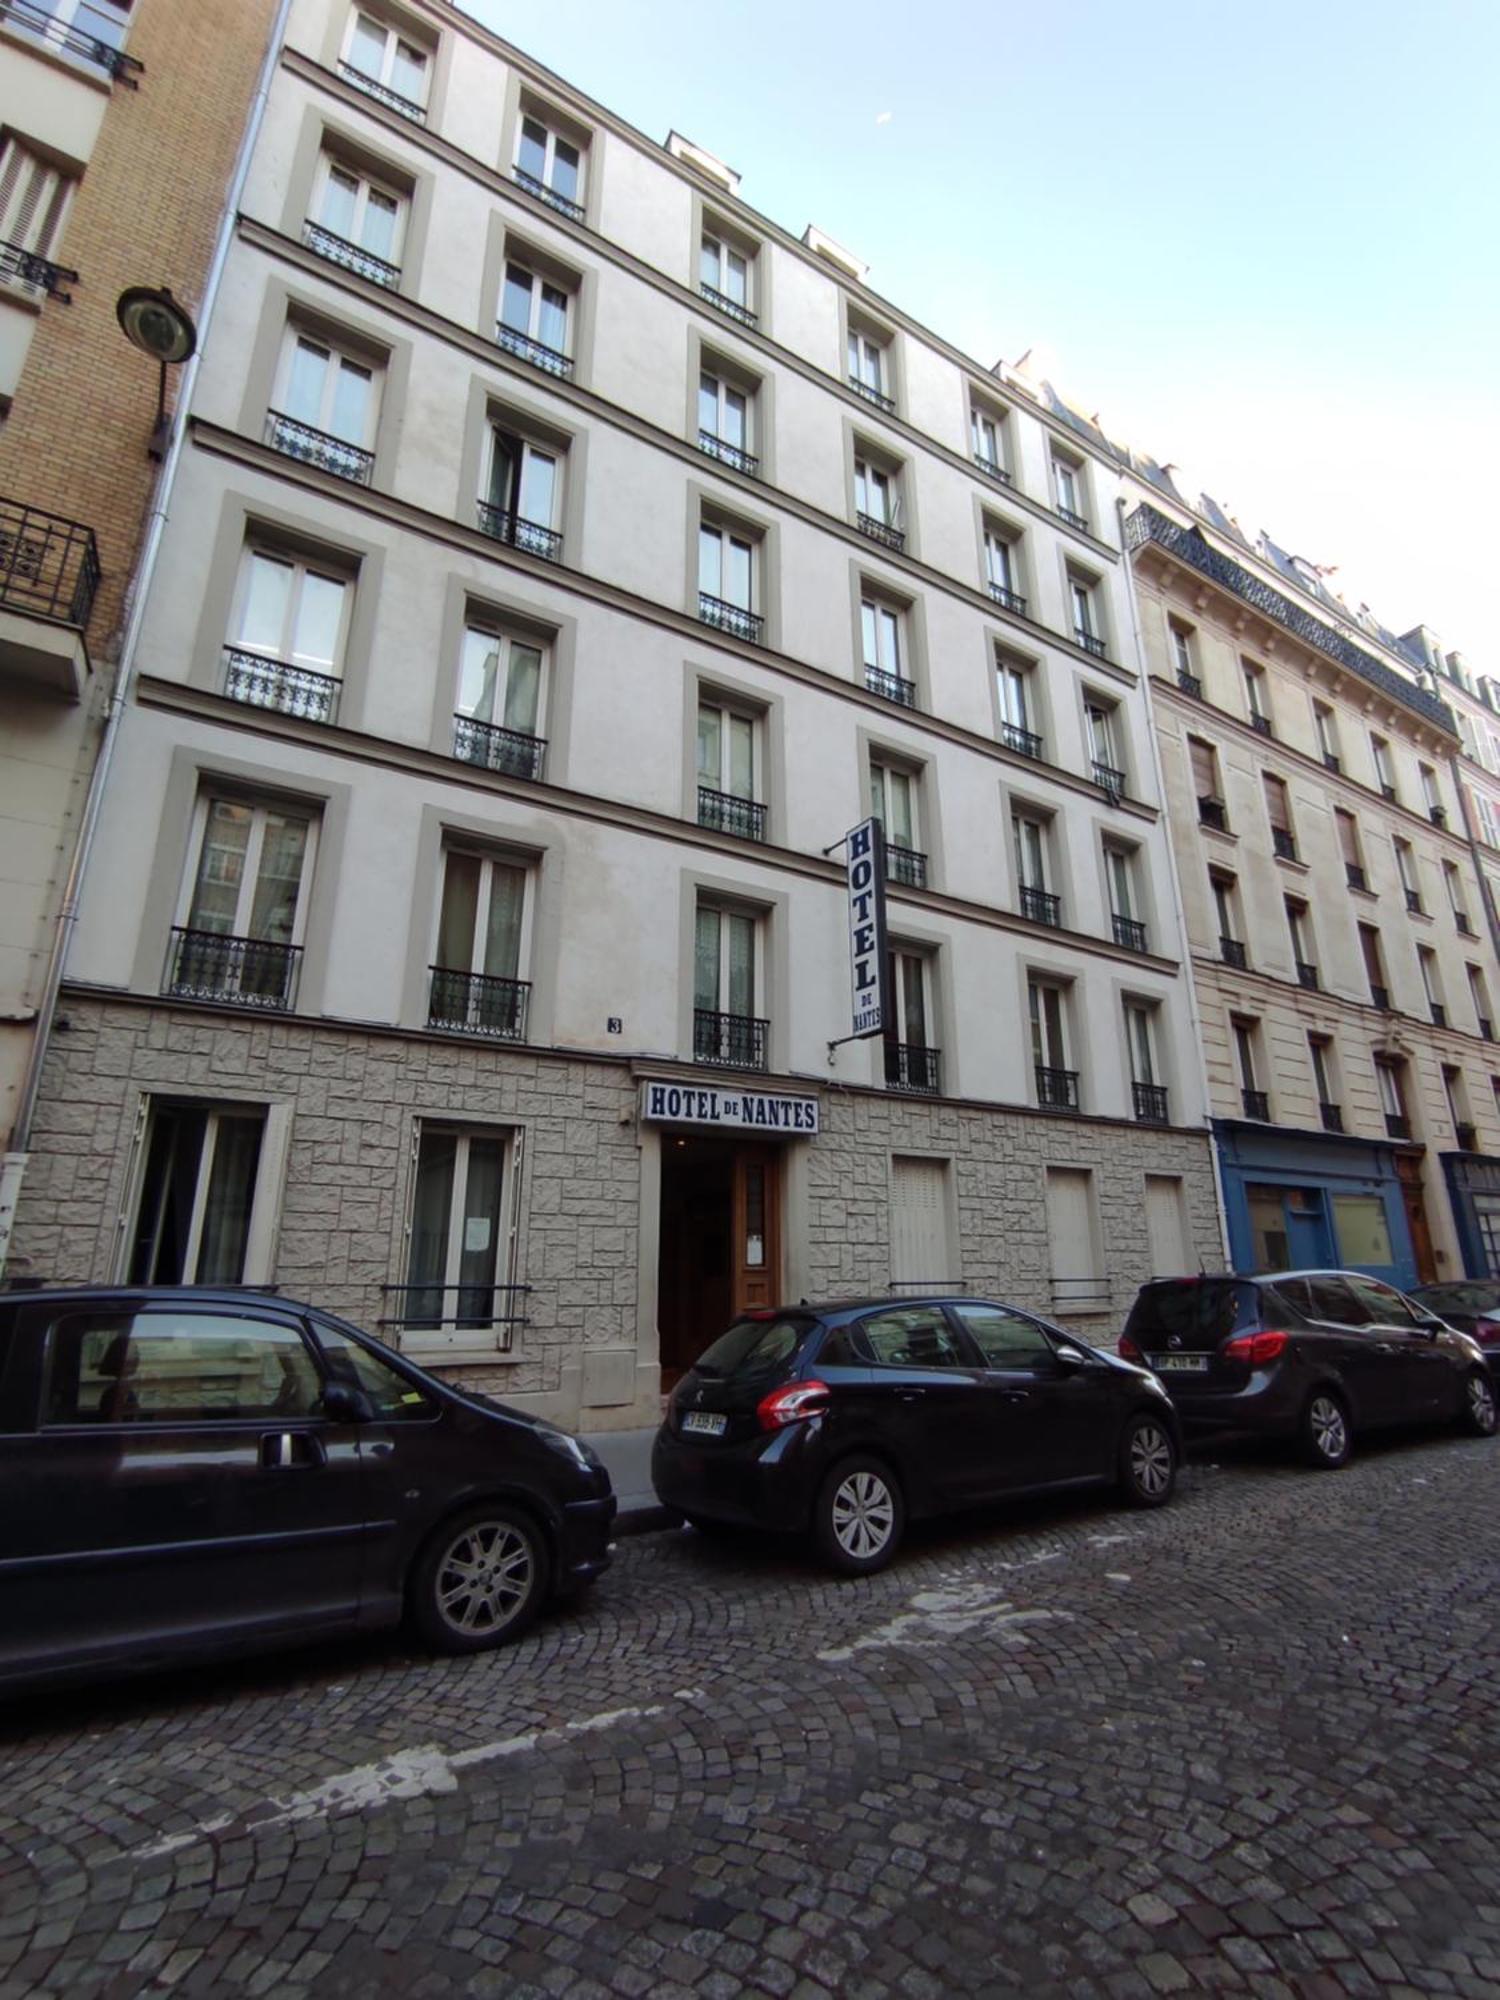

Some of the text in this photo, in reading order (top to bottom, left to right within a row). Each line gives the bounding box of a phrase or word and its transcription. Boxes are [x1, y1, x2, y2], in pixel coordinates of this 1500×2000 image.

[850, 826, 876, 992] HOTEL
[861, 992, 873, 1008] DE
[651, 1087, 815, 1128] HOTEL DE NANTES
